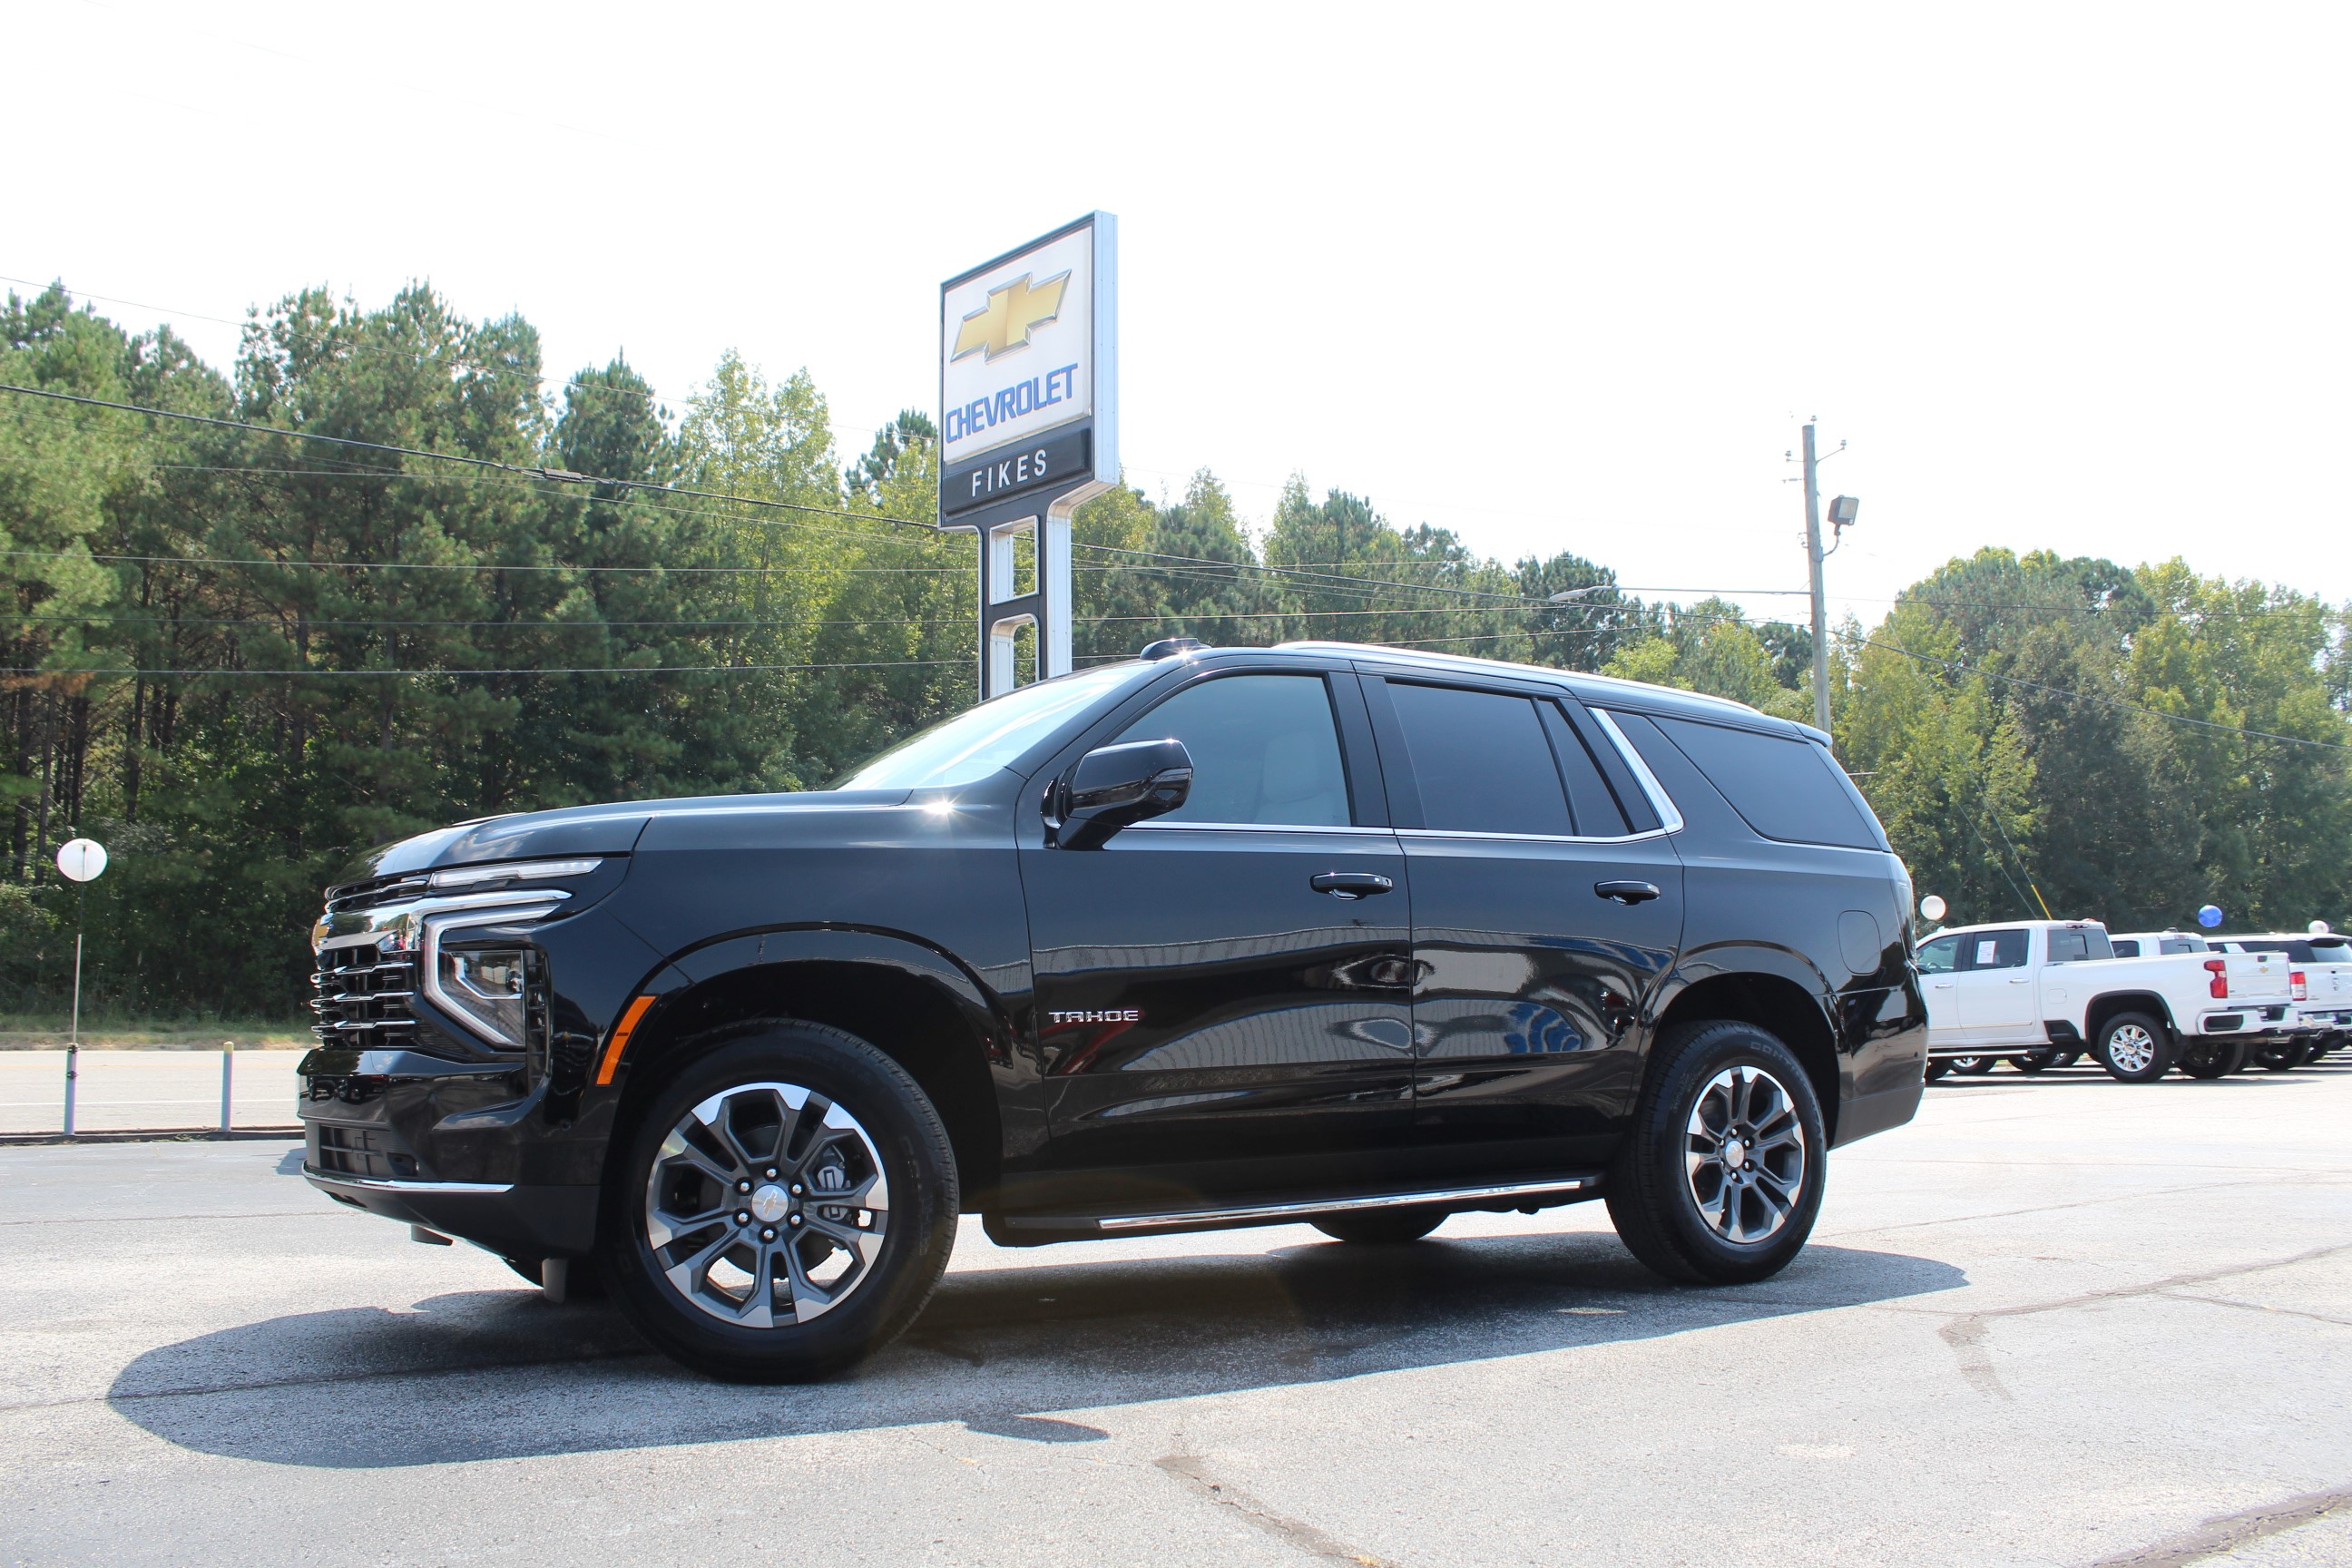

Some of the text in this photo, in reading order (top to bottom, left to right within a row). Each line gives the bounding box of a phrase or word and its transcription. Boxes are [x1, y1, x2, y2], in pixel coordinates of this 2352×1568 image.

[946, 363, 1078, 443] CHEVROLET
[972, 449, 1046, 497] FIKES
[1048, 1010, 1139, 1024] TAHOE
